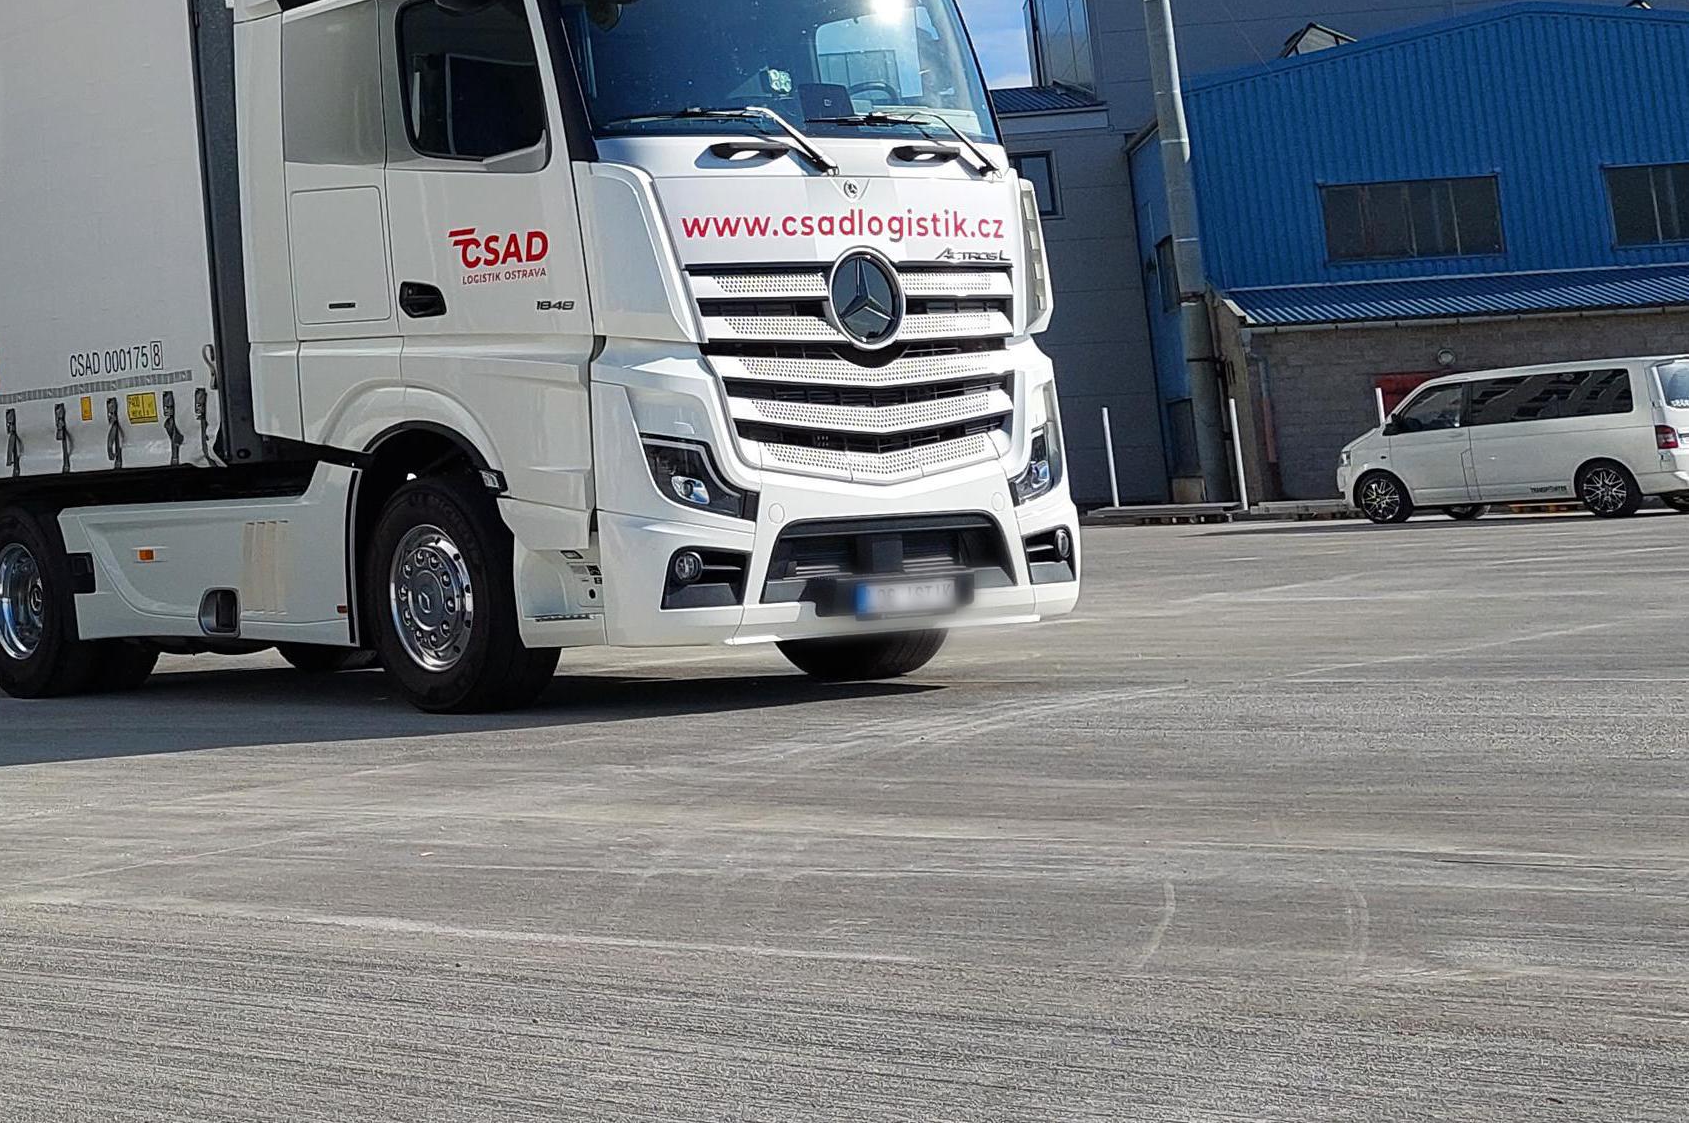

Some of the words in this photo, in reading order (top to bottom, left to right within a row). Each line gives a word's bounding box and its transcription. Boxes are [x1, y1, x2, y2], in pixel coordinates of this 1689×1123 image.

[682, 209, 1004, 242] www.csadlogistik.cz
[462, 272, 501, 285] LOGISTIK
[505, 268, 547, 280] OSTRAVA
[536, 301, 575, 310] 1848
[70, 352, 100, 377] CSAD
[105, 345, 149, 374] 000175
[152, 343, 161, 368] 8
